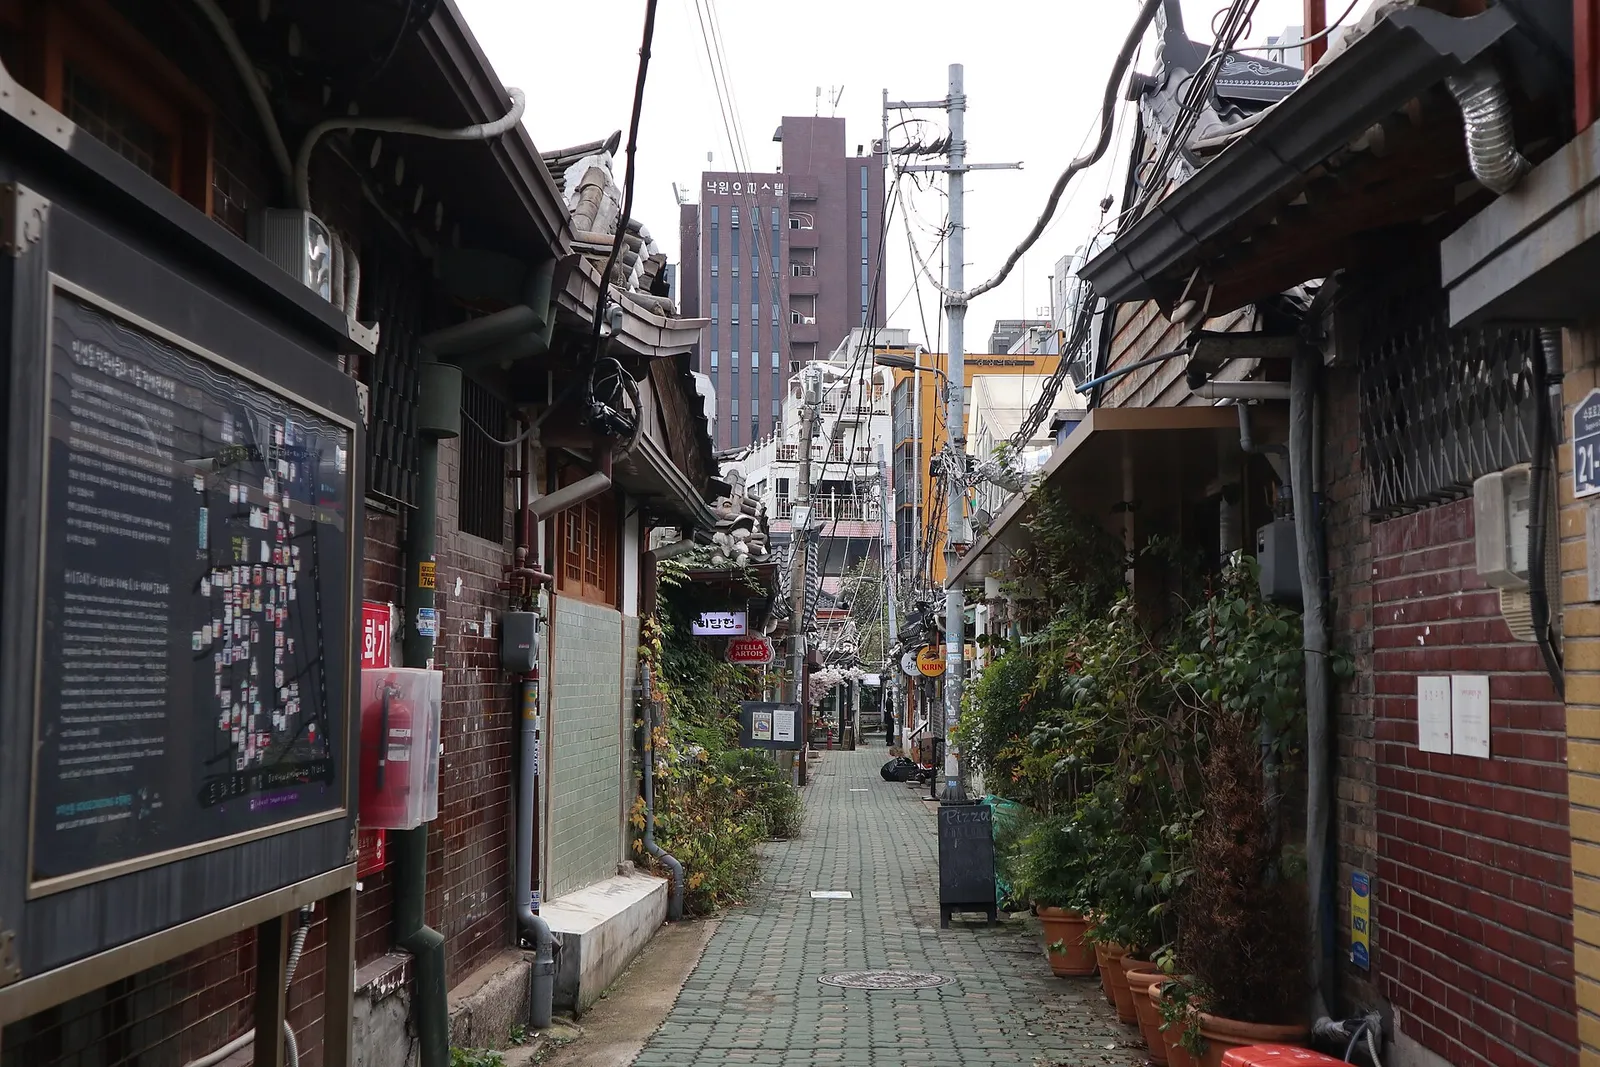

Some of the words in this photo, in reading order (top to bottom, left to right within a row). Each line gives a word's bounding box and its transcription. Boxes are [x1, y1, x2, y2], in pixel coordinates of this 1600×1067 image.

[706, 181, 784, 197] 낙원오피스텔
[1578, 443, 1600, 483] 21-
[361, 619, 388, 666] 화기
[942, 808, 990, 825] Pizza
